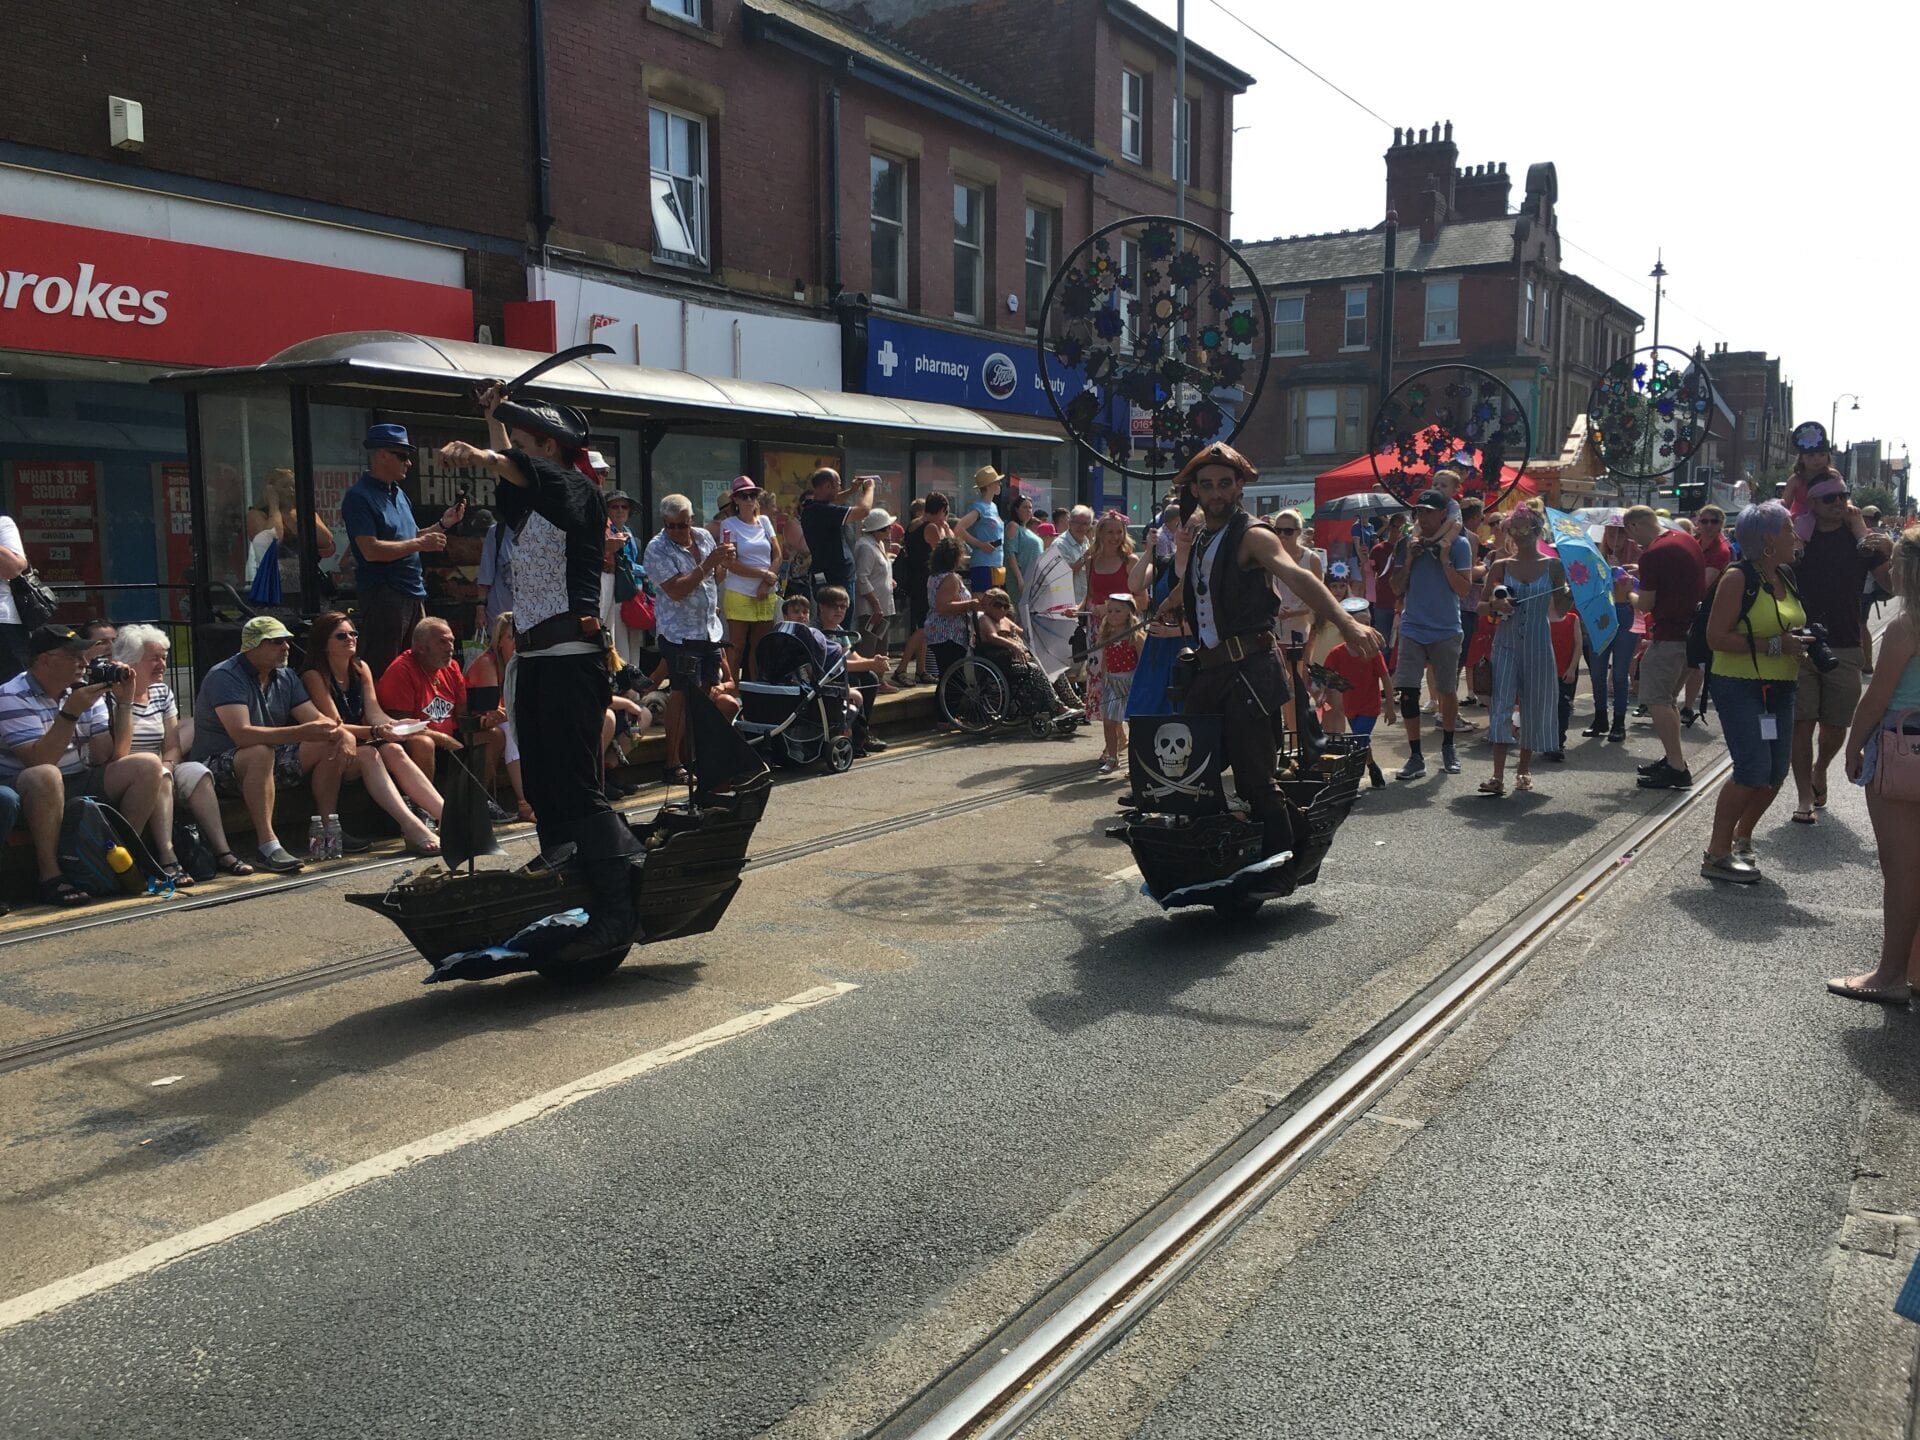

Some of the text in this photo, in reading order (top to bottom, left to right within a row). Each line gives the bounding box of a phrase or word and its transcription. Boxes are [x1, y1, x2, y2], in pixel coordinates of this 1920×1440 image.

[915, 353, 970, 381] pharmacy
[990, 362, 1016, 387] Boots
[1034, 373, 1066, 396] beuty
[18, 470, 89, 484] WHAT'S THE
[703, 482, 729, 490] TO LET
[31, 485, 77, 499] SCORE?
[420, 476, 497, 507] HURR
